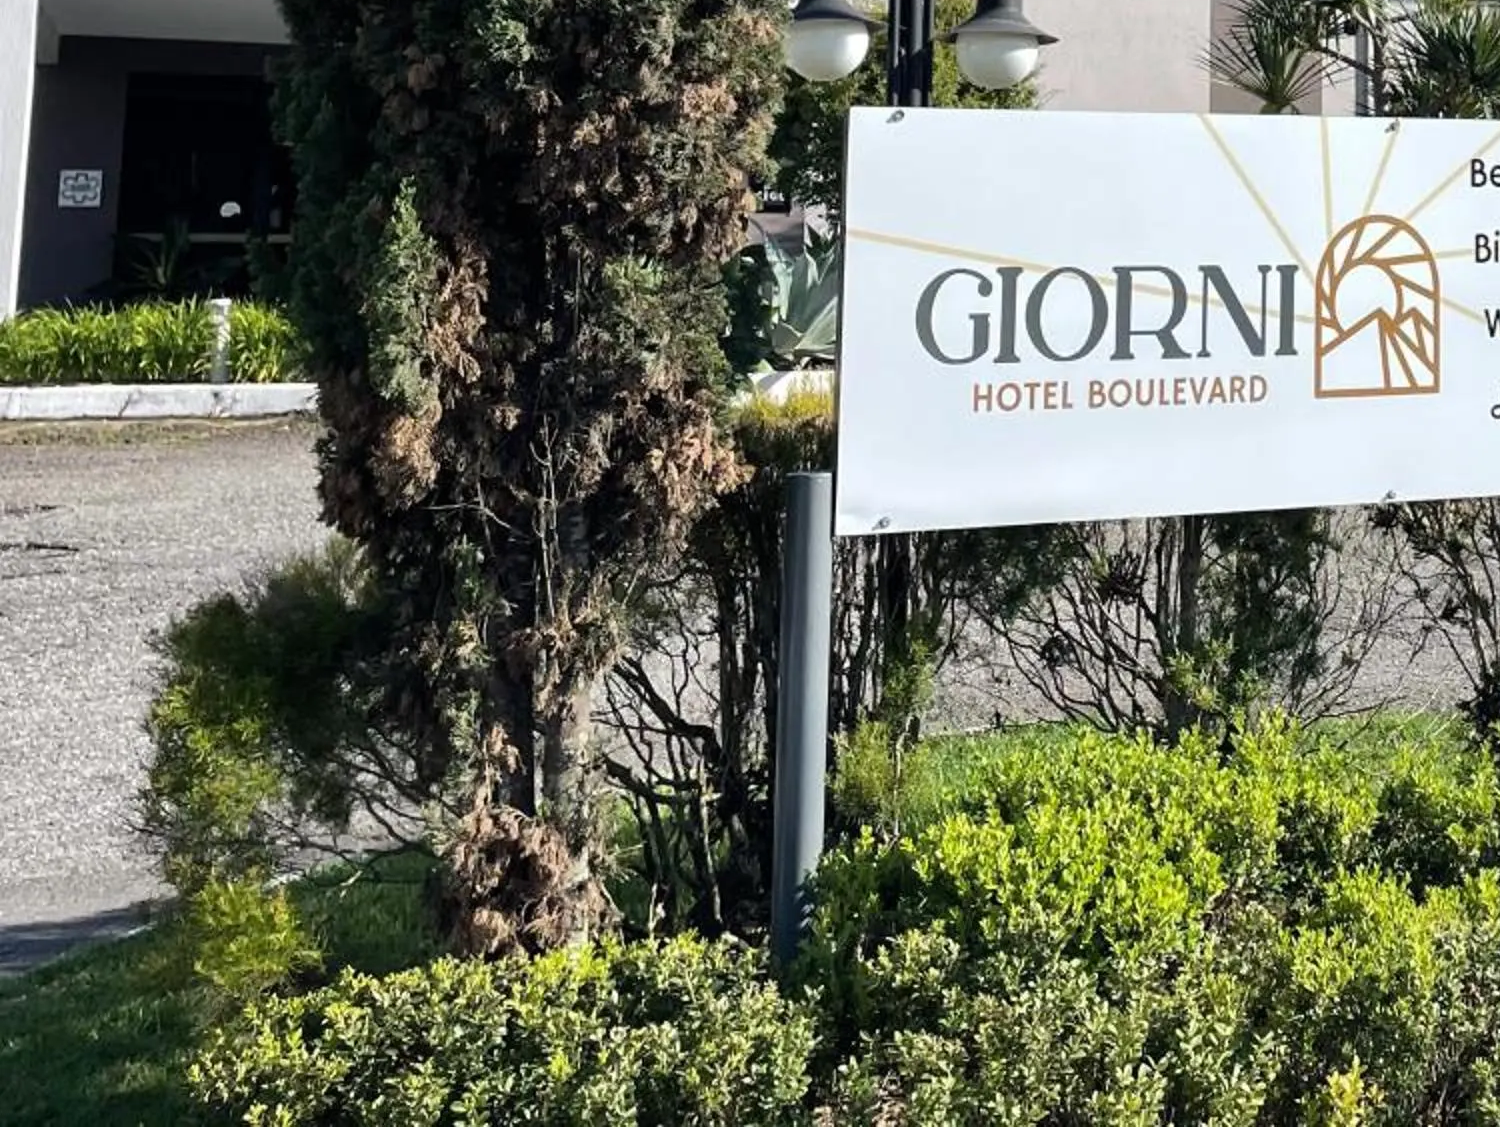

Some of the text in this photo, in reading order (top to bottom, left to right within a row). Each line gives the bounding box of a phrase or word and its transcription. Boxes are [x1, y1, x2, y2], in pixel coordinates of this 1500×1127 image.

[915, 264, 1300, 365] GIORNI
[973, 375, 1268, 412] HOTEL BOULEVARD
